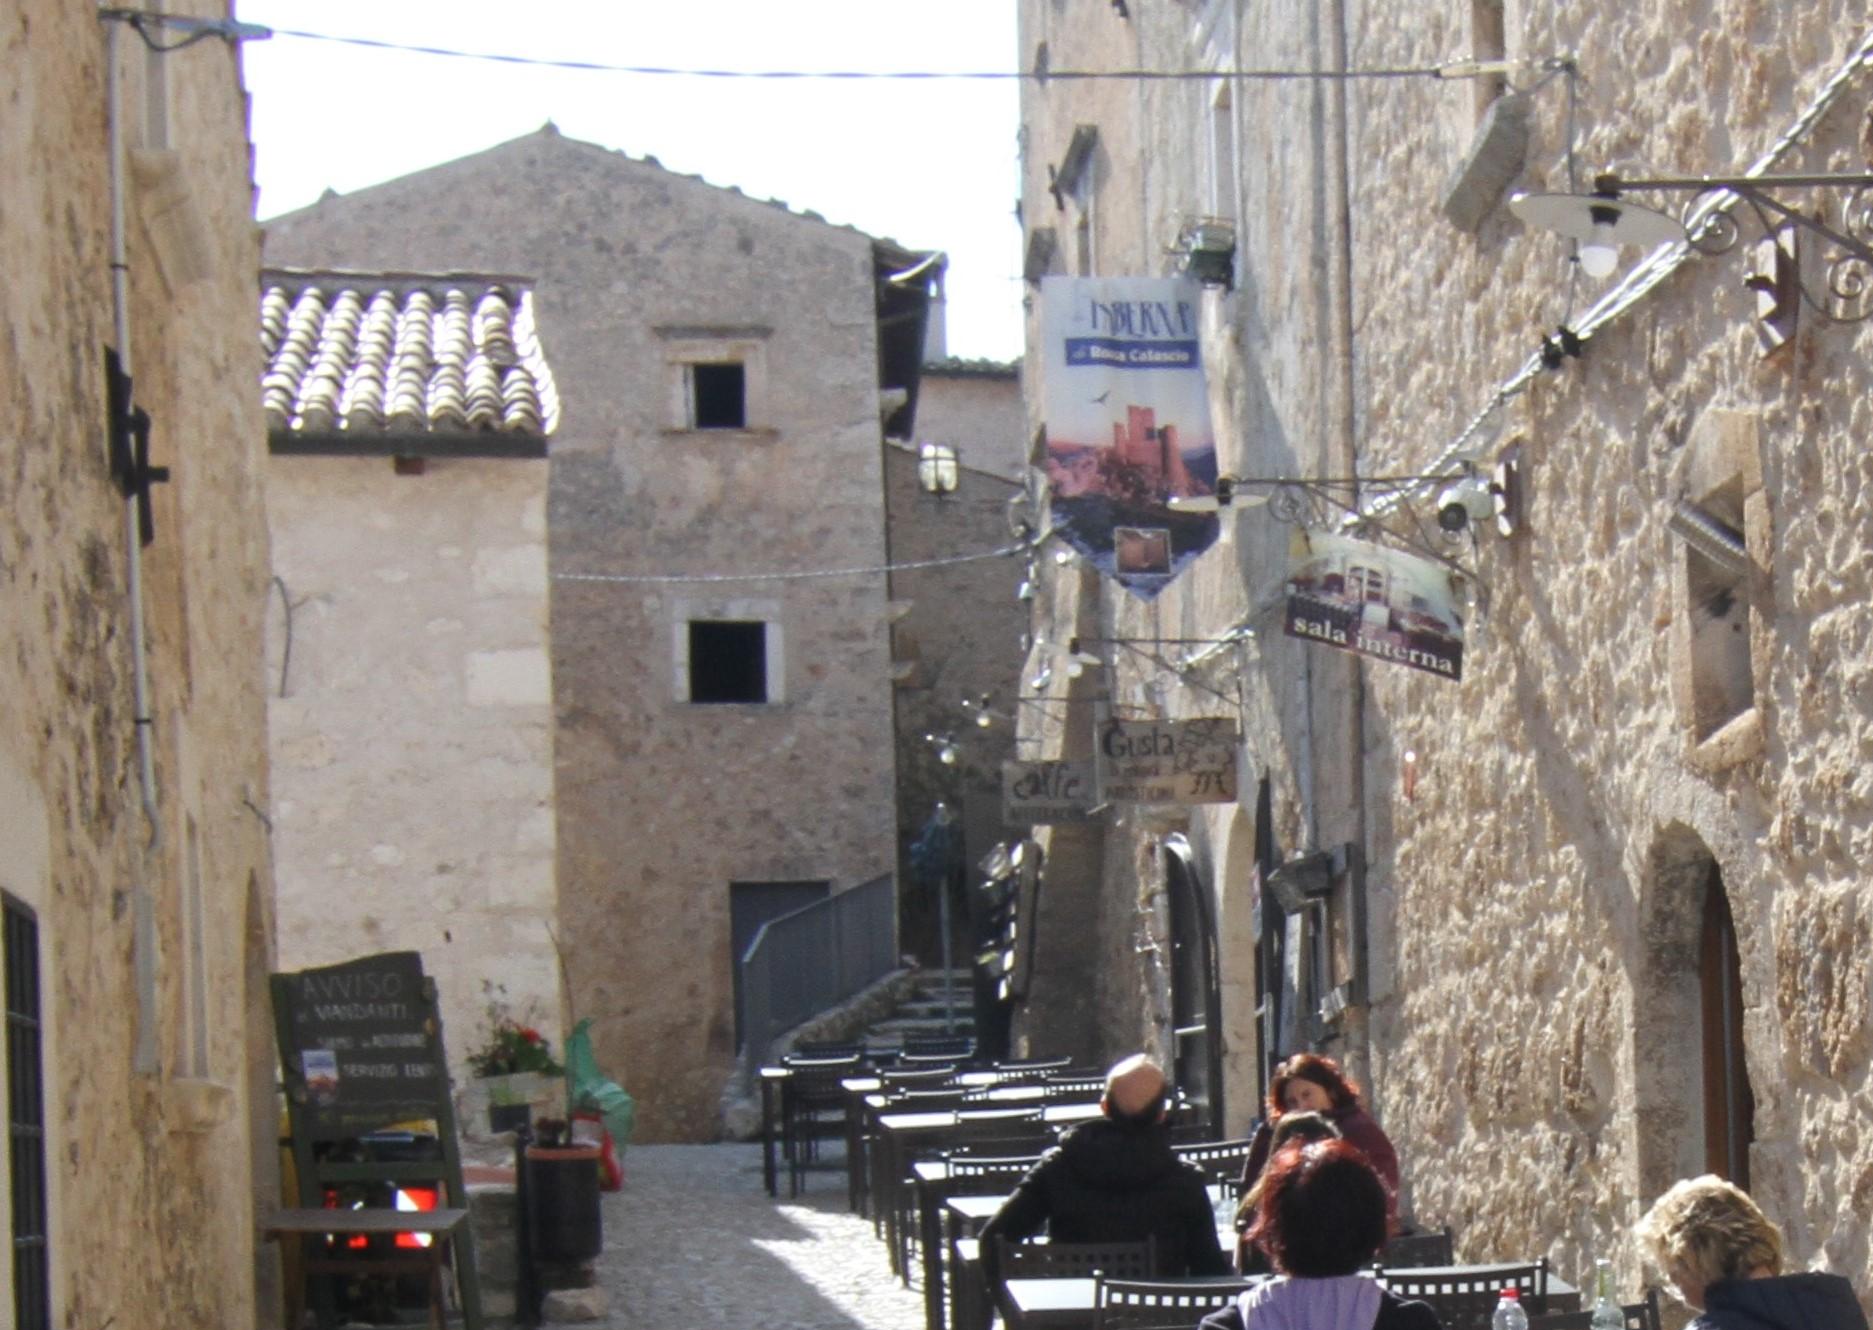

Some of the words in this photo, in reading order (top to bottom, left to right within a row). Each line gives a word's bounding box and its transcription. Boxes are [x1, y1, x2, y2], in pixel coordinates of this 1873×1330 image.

[1294, 616, 1348, 645] sala
[1356, 629, 1454, 674] interna
[303, 972, 402, 1000] AVVISO
